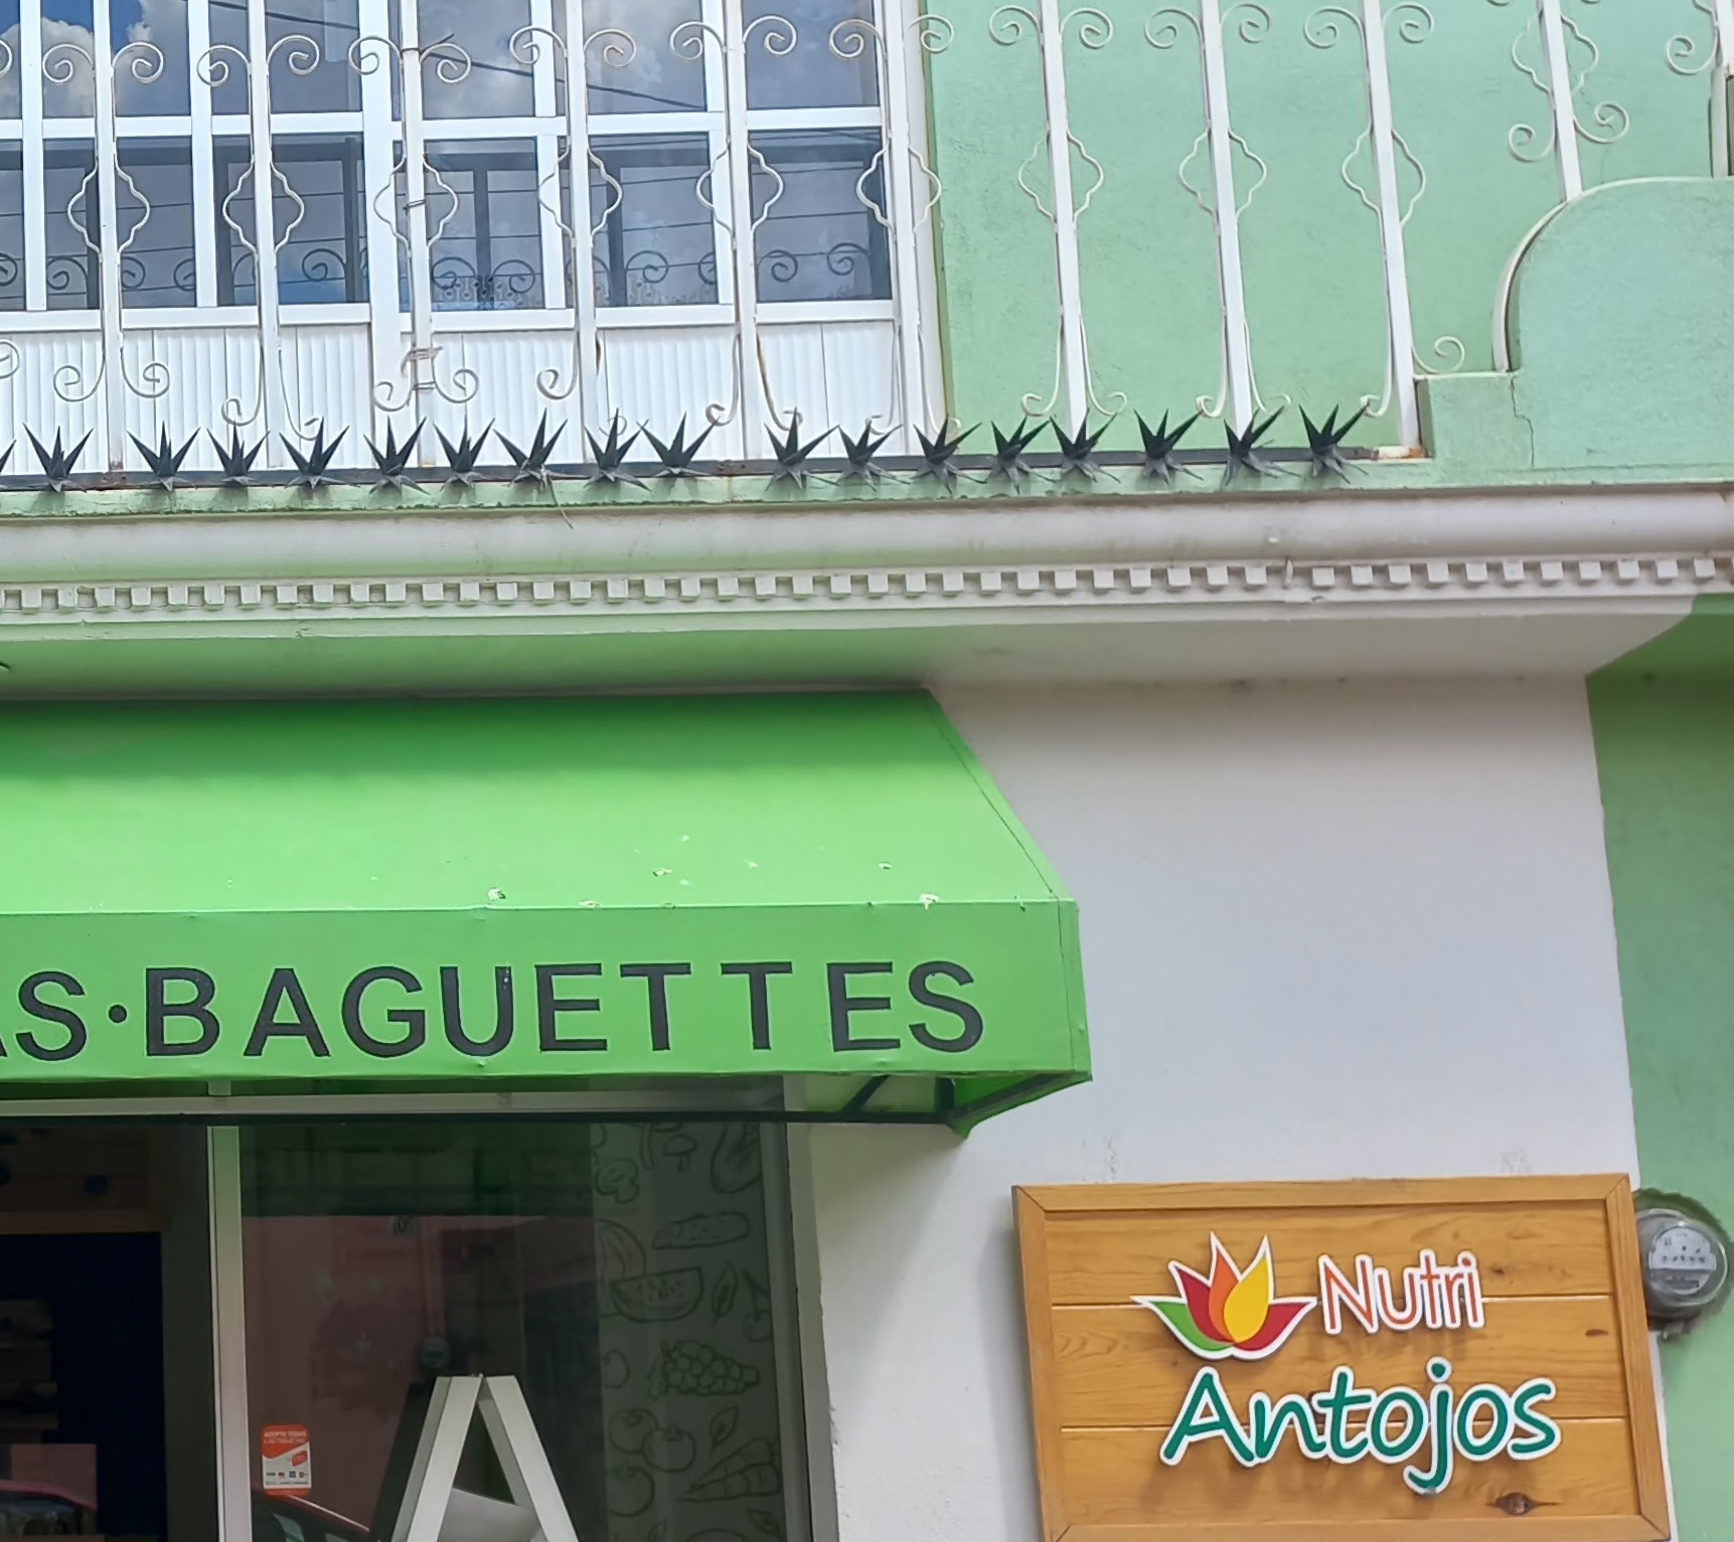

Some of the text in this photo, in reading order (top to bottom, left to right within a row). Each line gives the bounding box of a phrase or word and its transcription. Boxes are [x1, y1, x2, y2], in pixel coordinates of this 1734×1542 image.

[145, 961, 984, 1059] BAGUETTES
[1319, 1249, 1483, 1334] Nutri
[1159, 1356, 1562, 1495] Antojos
